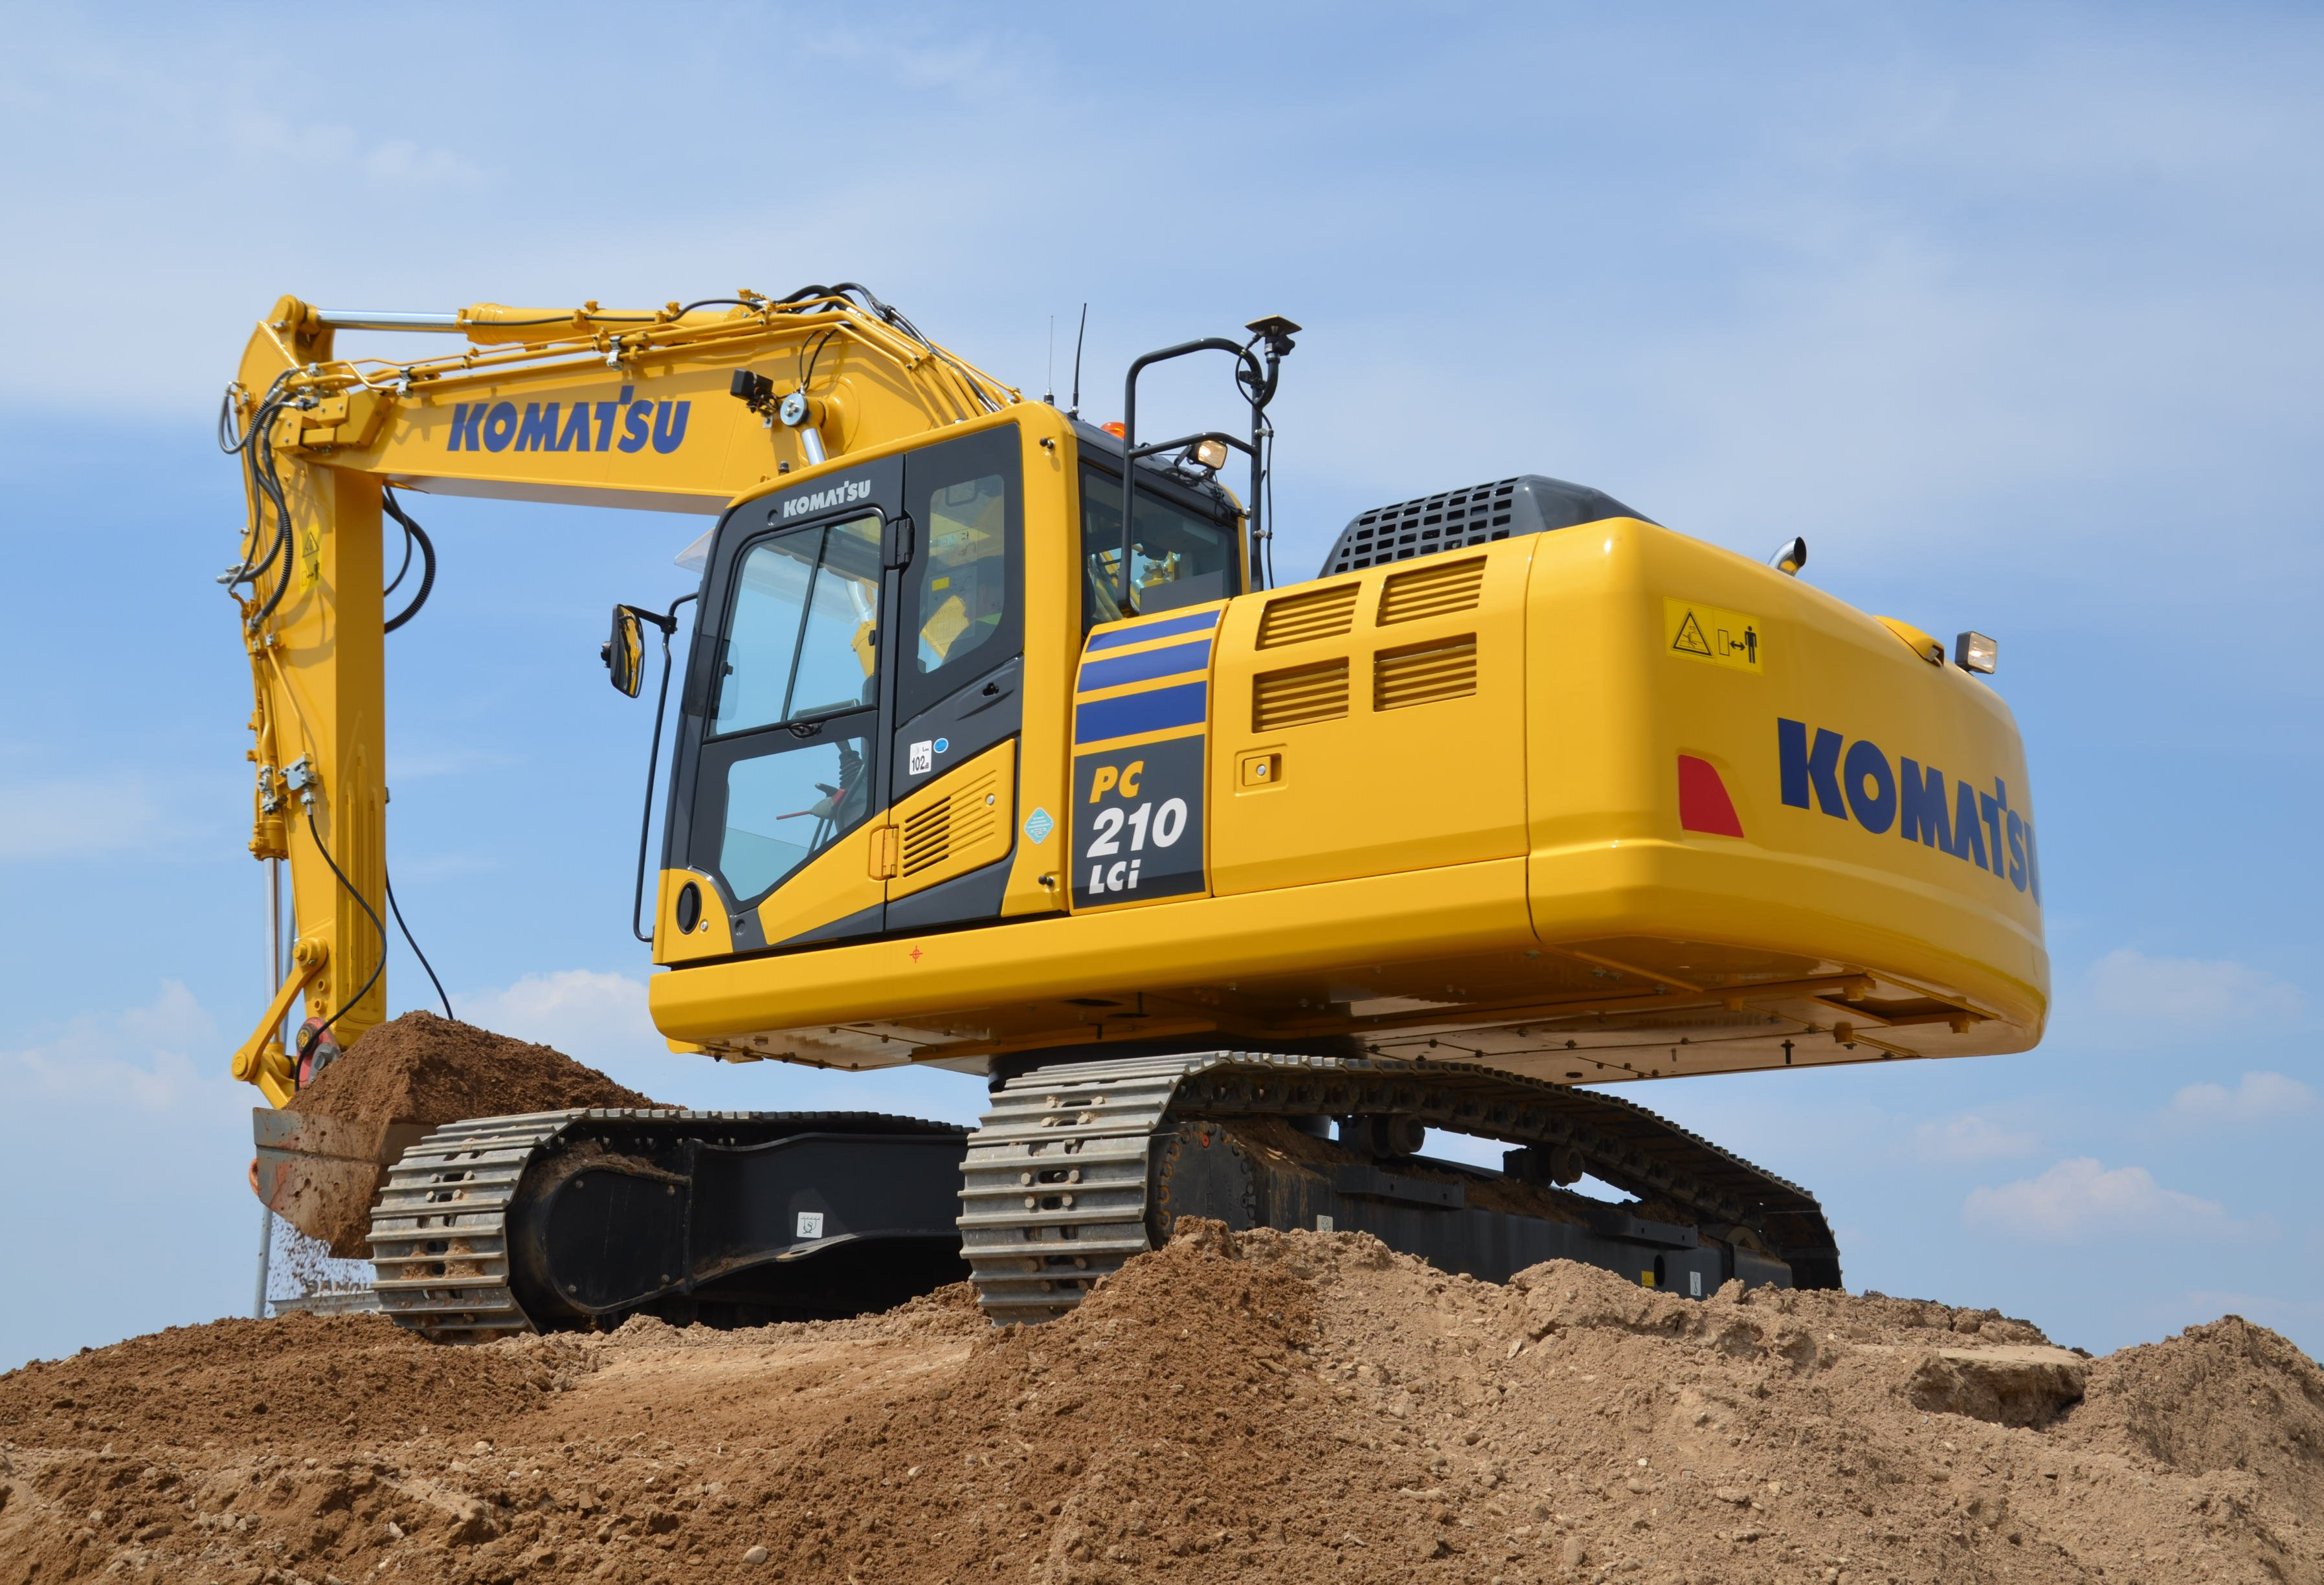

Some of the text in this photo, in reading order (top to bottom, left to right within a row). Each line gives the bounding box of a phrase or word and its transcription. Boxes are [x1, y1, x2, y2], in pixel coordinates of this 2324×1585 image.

[448, 385, 691, 454] KOMATSU
[783, 479, 871, 518] KOMATSU
[911, 755, 925, 771] 102
[1089, 761, 1144, 804] PC
[1086, 798, 1187, 858] 210
[1089, 859, 1141, 894] LCi
